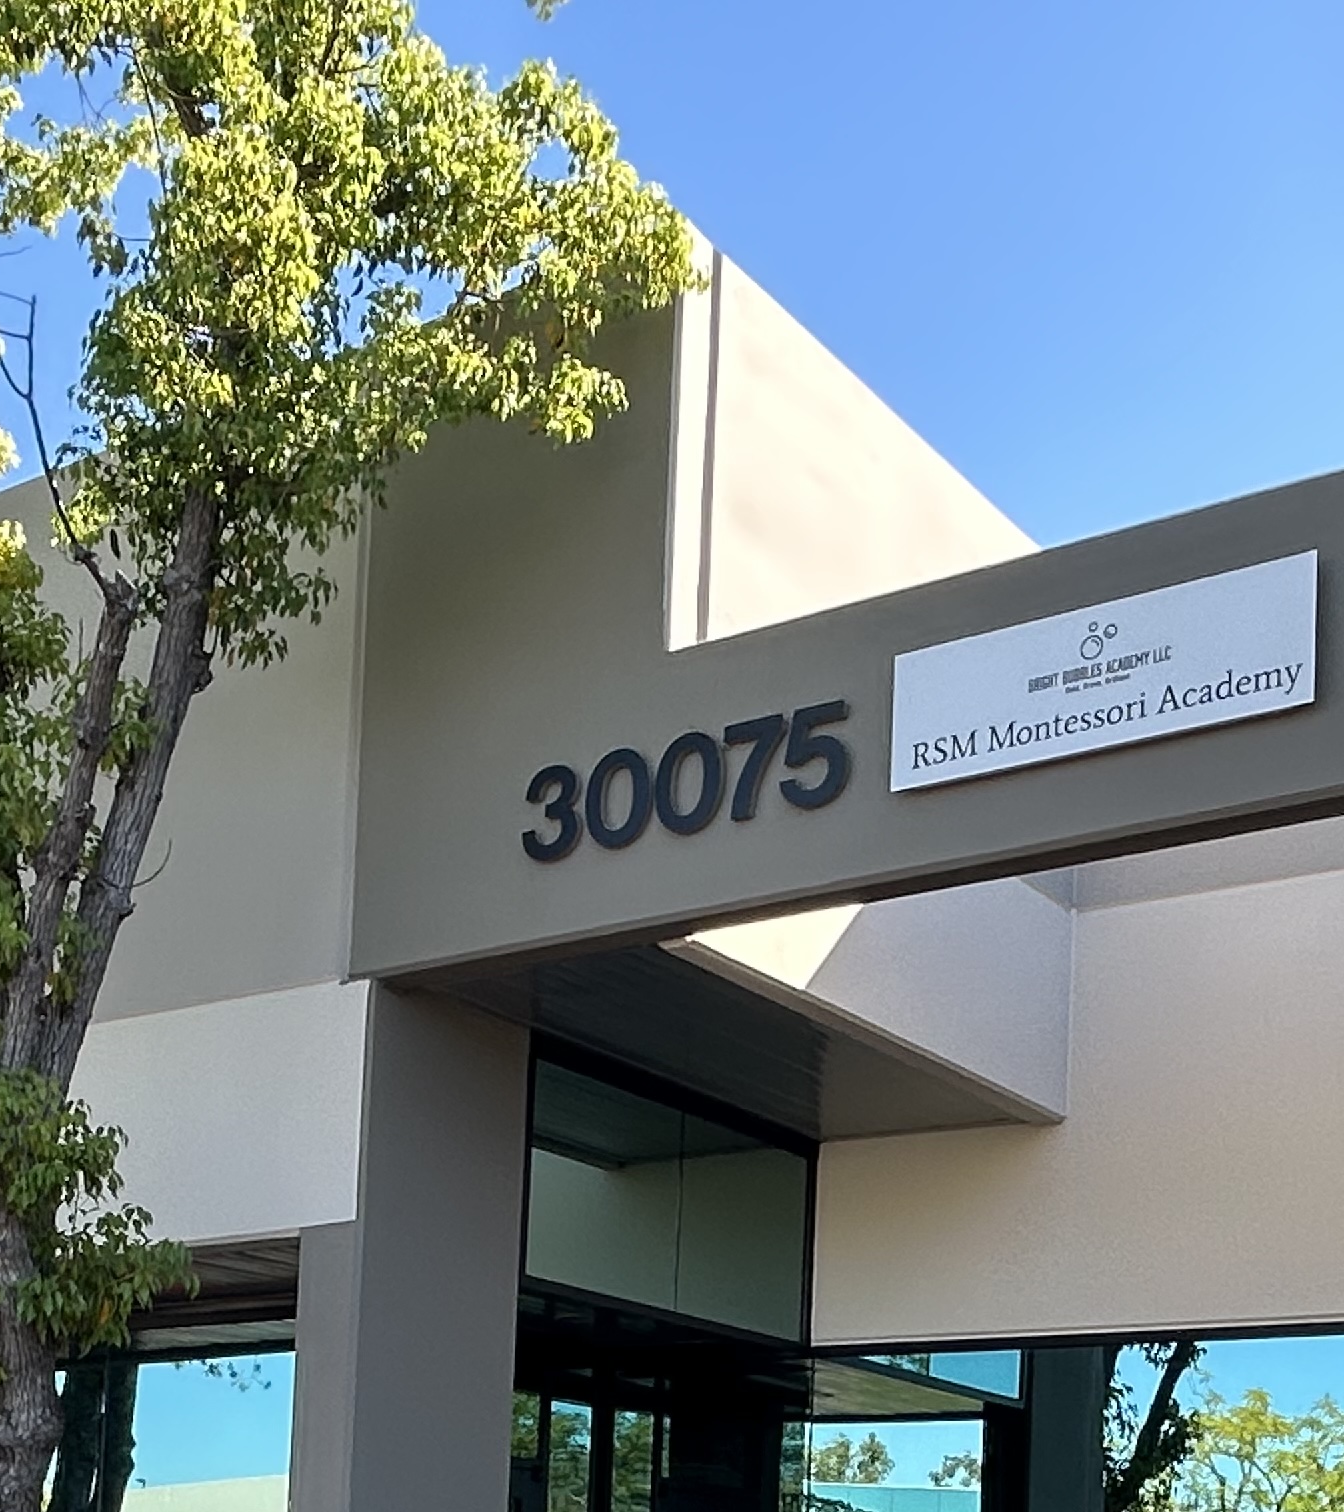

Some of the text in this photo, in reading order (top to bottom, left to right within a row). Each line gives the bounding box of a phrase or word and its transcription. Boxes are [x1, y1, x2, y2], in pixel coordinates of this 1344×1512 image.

[1106, 651, 1151, 674] ACADEMY
[1153, 646, 1172, 664] LLC
[911, 662, 1304, 769] RSM Montessori Academy
[522, 700, 851, 862] 30075
